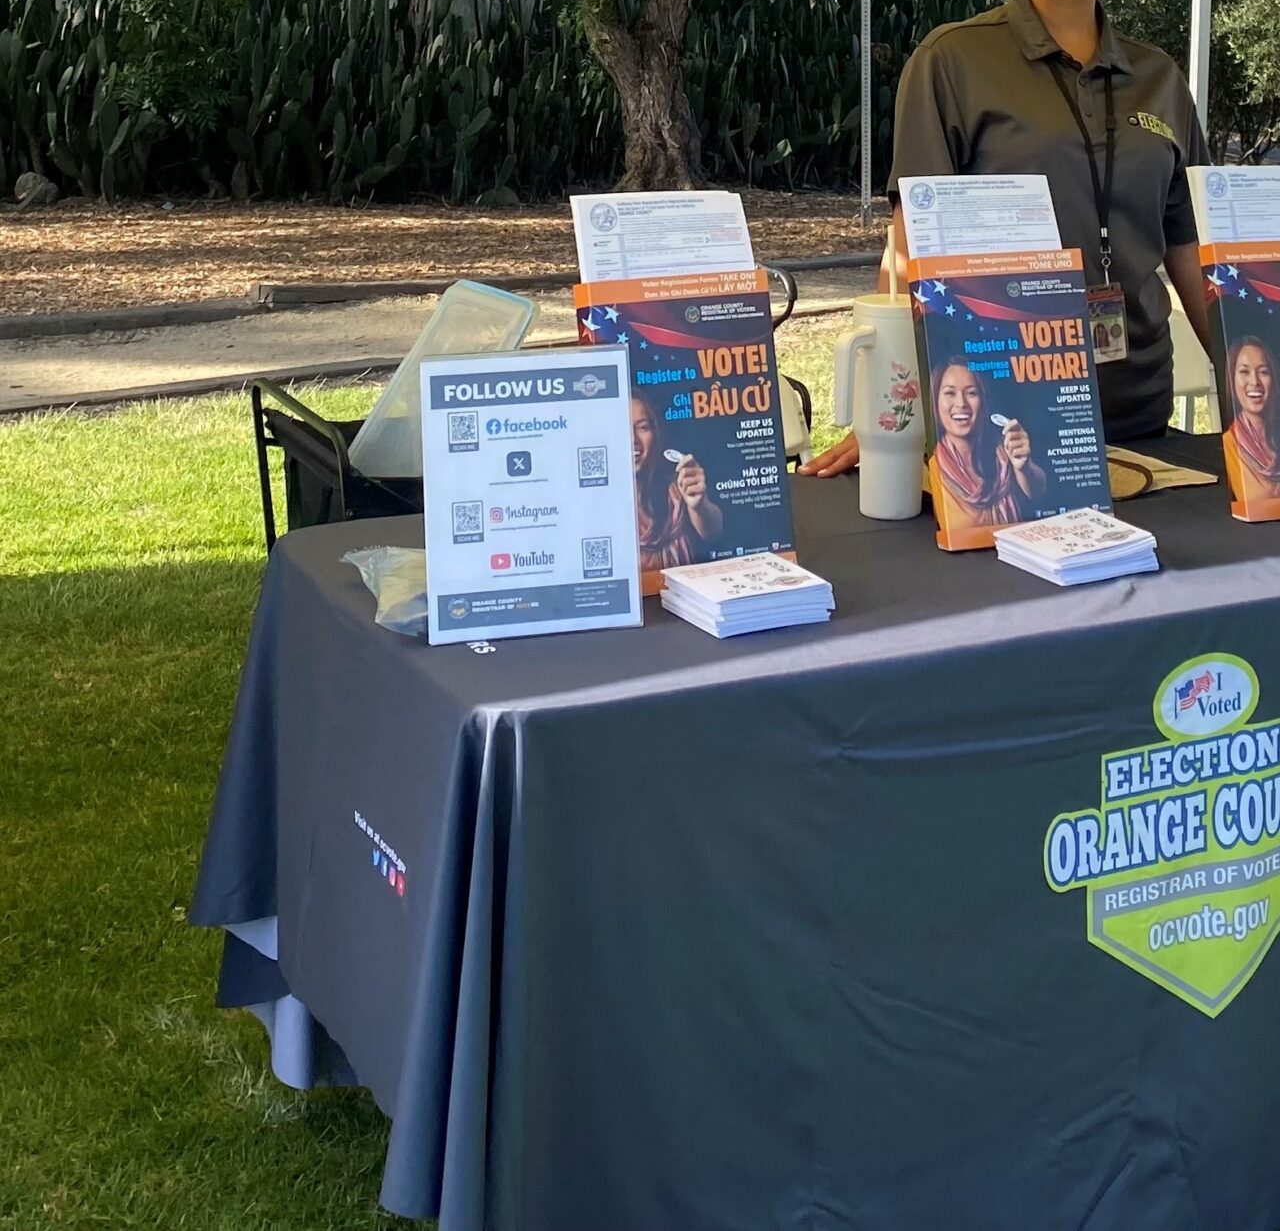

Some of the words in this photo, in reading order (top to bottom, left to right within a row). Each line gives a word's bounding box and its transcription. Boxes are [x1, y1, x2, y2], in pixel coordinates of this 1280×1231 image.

[1038, 253, 1055, 261] TAKE
[1056, 251, 1072, 259] ONE
[1241, 252, 1273, 260] Registration
[1028, 261, 1052, 270] TOME
[1053, 259, 1073, 269] UNO
[719, 273, 739, 282] TAKE
[740, 272, 757, 280] ONE
[1019, 318, 1085, 350] VOTE!
[964, 339, 1005, 355] Register
[1008, 338, 1019, 350] to
[697, 343, 769, 379] VOTE!
[1009, 351, 1089, 384] VOTAR!
[637, 369, 682, 385] Register
[685, 367, 696, 380] to
[993, 369, 1010, 381] para
[443, 380, 533, 402] FOLLOW
[536, 377, 565, 396] US
[1060, 386, 1078, 395] KEEP
[1079, 384, 1090, 393] US
[673, 393, 691, 408] Ghi
[1056, 393, 1092, 403] UPDATED
[665, 407, 693, 420] danh
[502, 414, 568, 435] facebook
[740, 420, 761, 429] KEEP
[762, 418, 773, 427] US
[736, 428, 774, 440] UPDATED
[1060, 437, 1074, 446] SUS
[1074, 436, 1097, 445] DATOS
[1047, 445, 1098, 457] ACTUALIZADOS
[760, 465, 778, 475] CHO
[505, 504, 560, 523] Instagram
[512, 550, 556, 568] YouTube
[471, 599, 497, 607] ORANGE
[498, 597, 523, 605] COUNTY
[1215, 672, 1224, 691] I
[1197, 691, 1242, 719] Voted
[1049, 794, 1207, 885] ORANGE
[1104, 872, 1208, 911] REGISTRAR
[1213, 866, 1238, 886] OF
[1149, 898, 1270, 951] ocvote.gov
